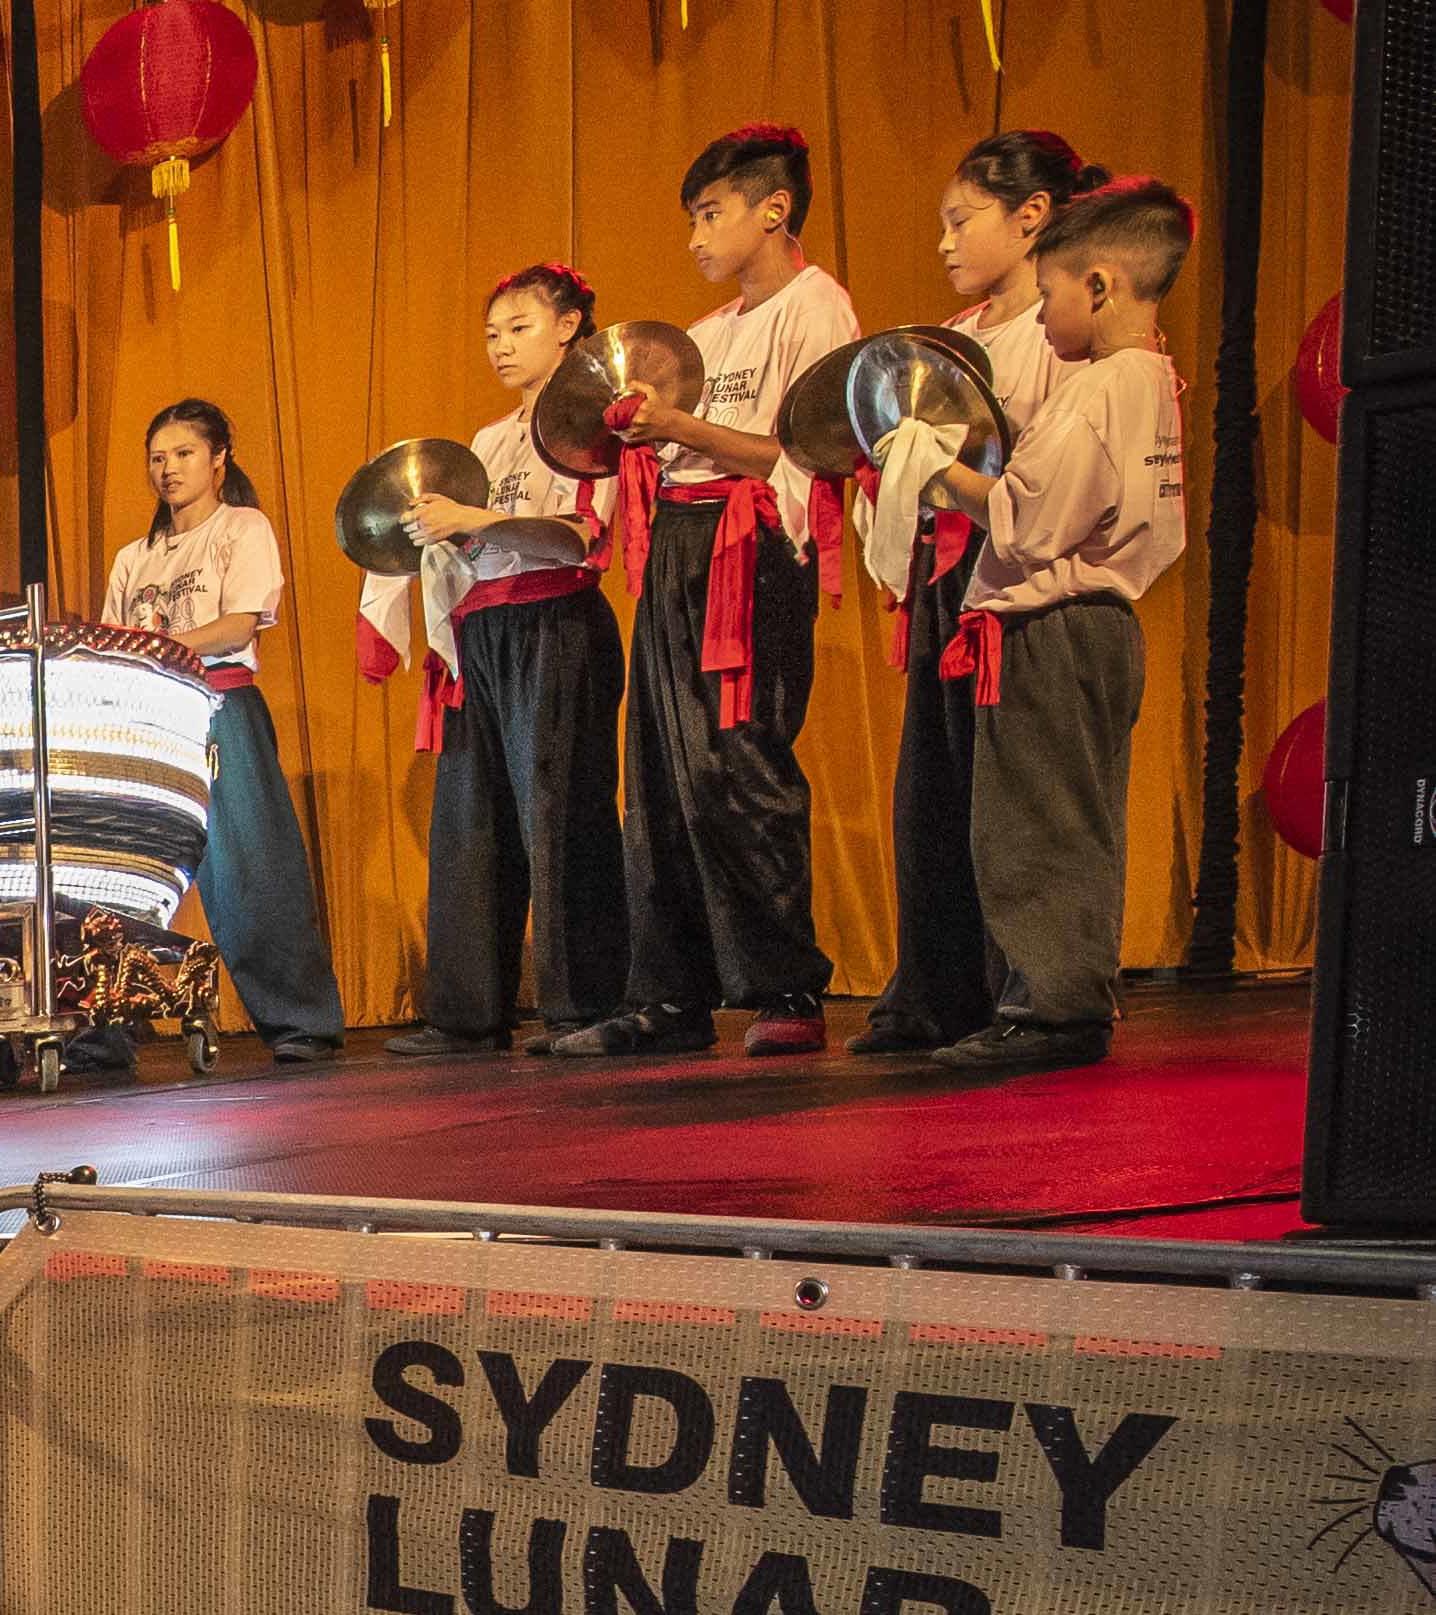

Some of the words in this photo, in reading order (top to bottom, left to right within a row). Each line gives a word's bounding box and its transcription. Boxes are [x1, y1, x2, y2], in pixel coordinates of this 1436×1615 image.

[714, 381, 747, 393] UNAR
[712, 389, 756, 404] ESTIVAL
[494, 490, 532, 505] FESTAL
[1413, 777, 1426, 844] DYNACORD
[364, 1340, 1179, 1551] SYDNEY
